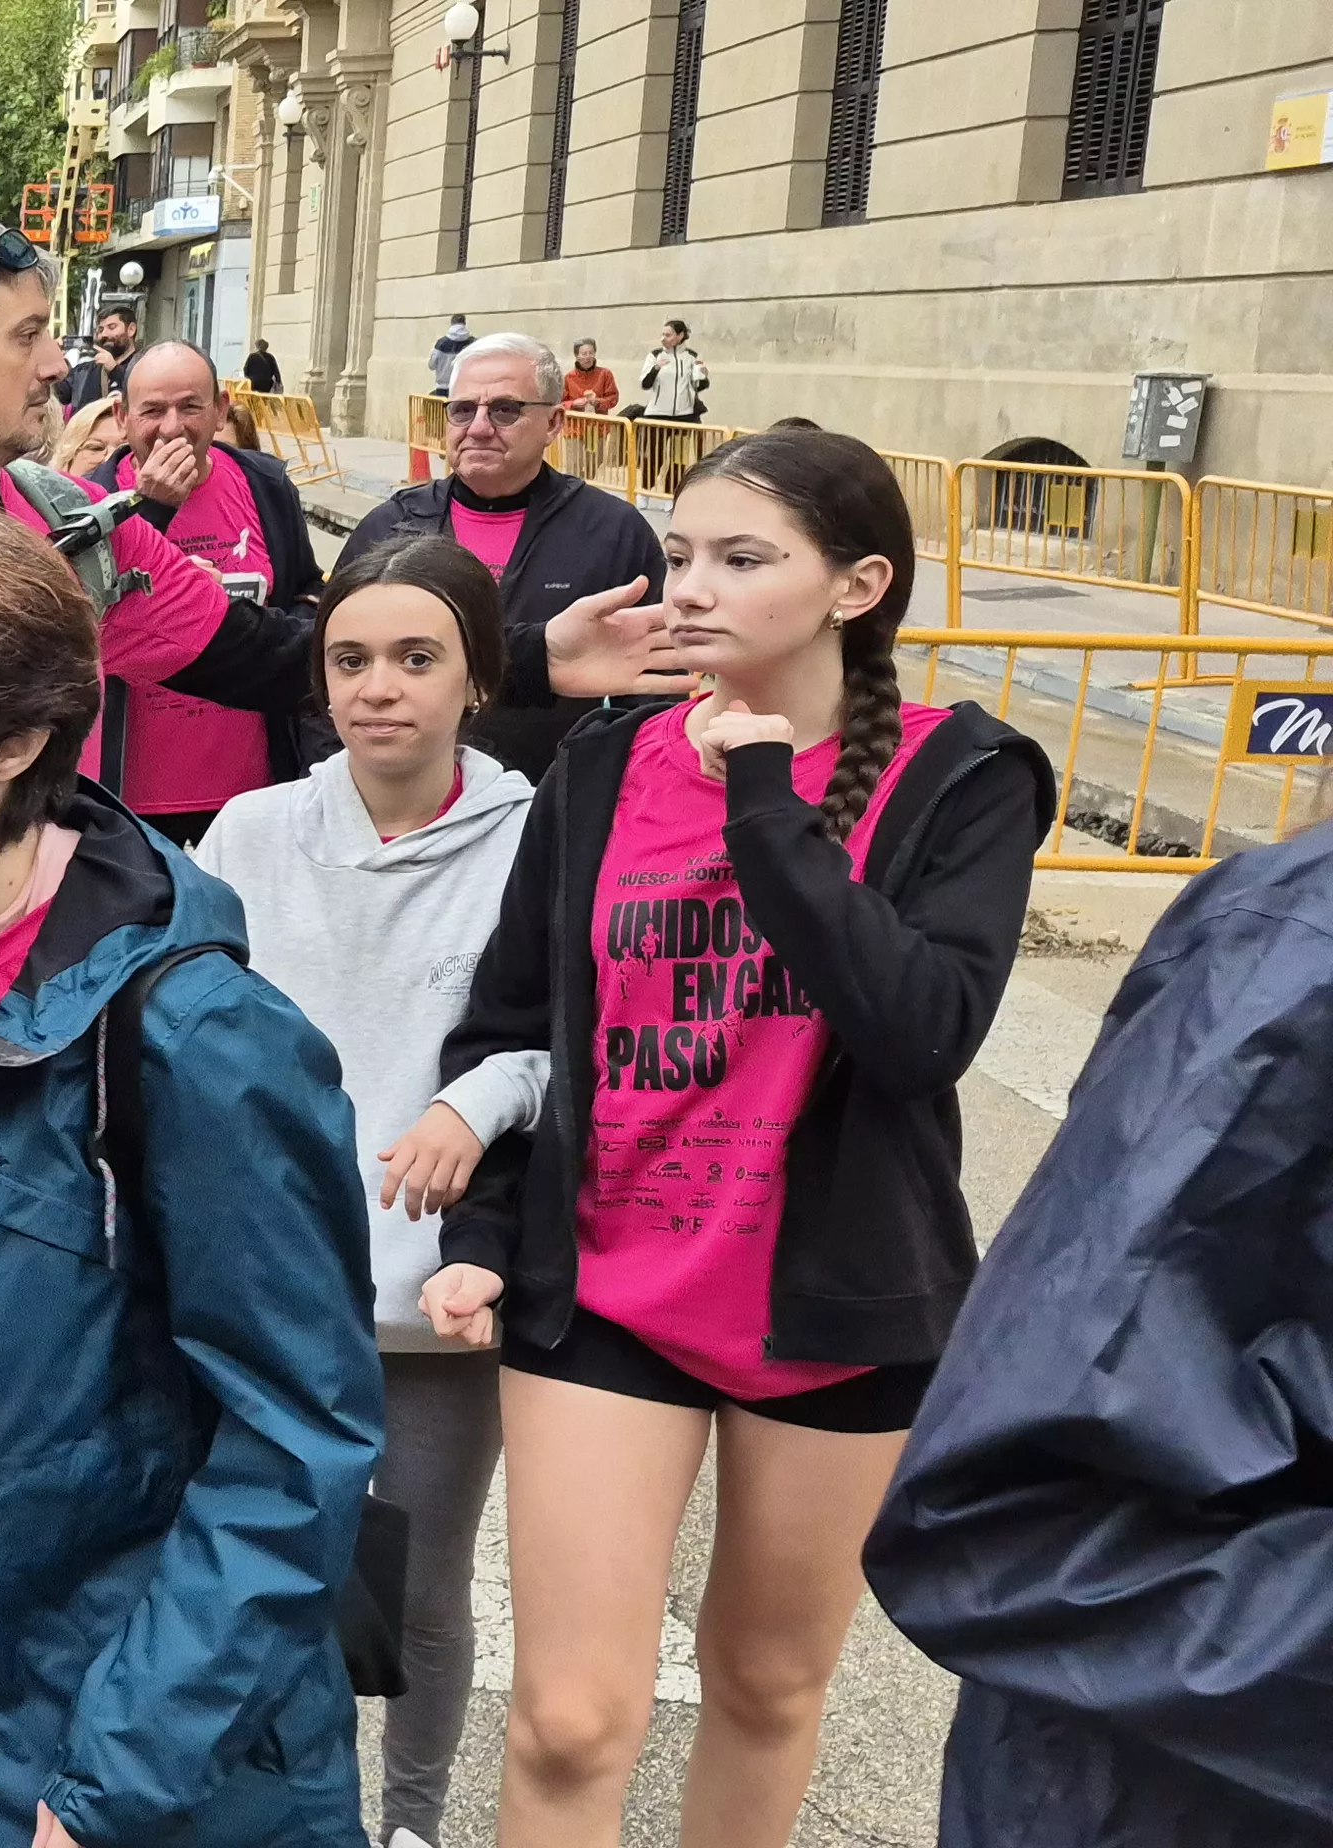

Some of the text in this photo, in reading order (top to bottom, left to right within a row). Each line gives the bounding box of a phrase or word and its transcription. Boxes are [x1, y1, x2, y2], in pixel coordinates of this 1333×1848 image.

[617, 870, 680, 887] HUESCA
[672, 960, 728, 1022] EN
[605, 1024, 728, 1092] PASO
